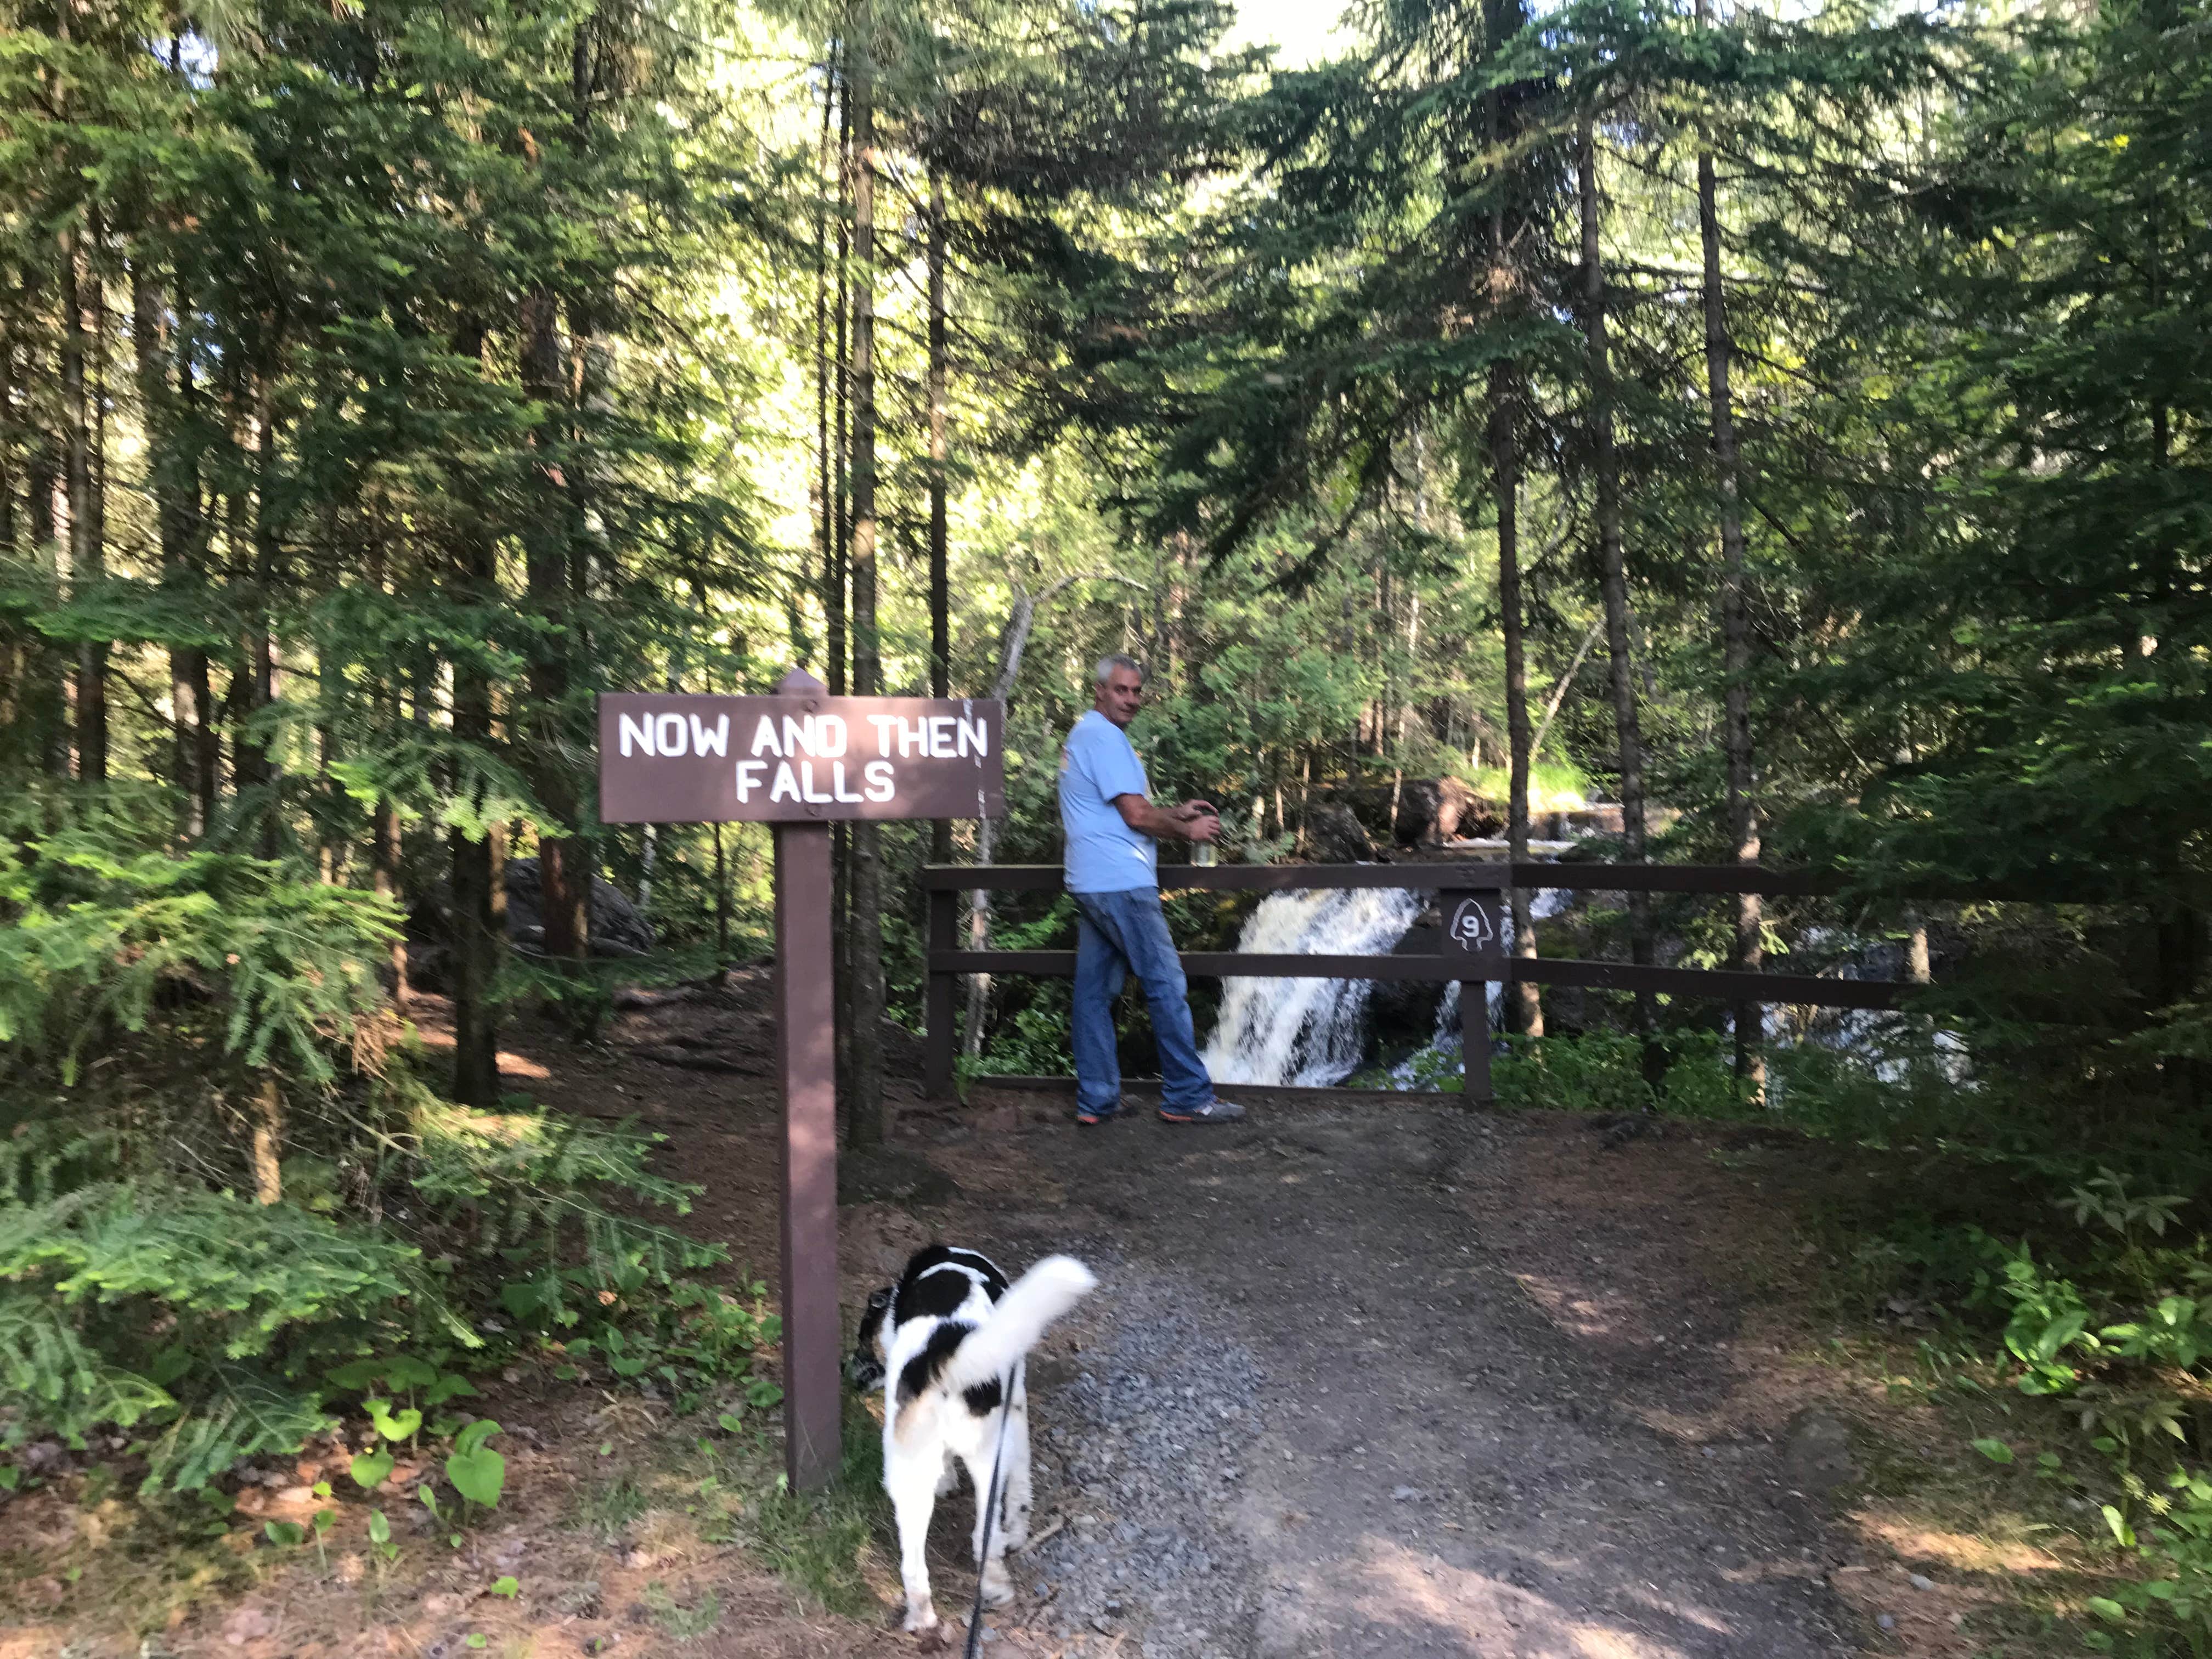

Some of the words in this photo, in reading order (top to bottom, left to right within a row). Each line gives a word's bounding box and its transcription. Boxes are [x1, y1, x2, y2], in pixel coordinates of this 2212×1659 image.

[618, 712, 730, 758] NOW
[751, 715, 848, 759] AND
[867, 715, 988, 759] THEN
[735, 760, 895, 804] FALLS
[1462, 915, 1480, 938] 9
